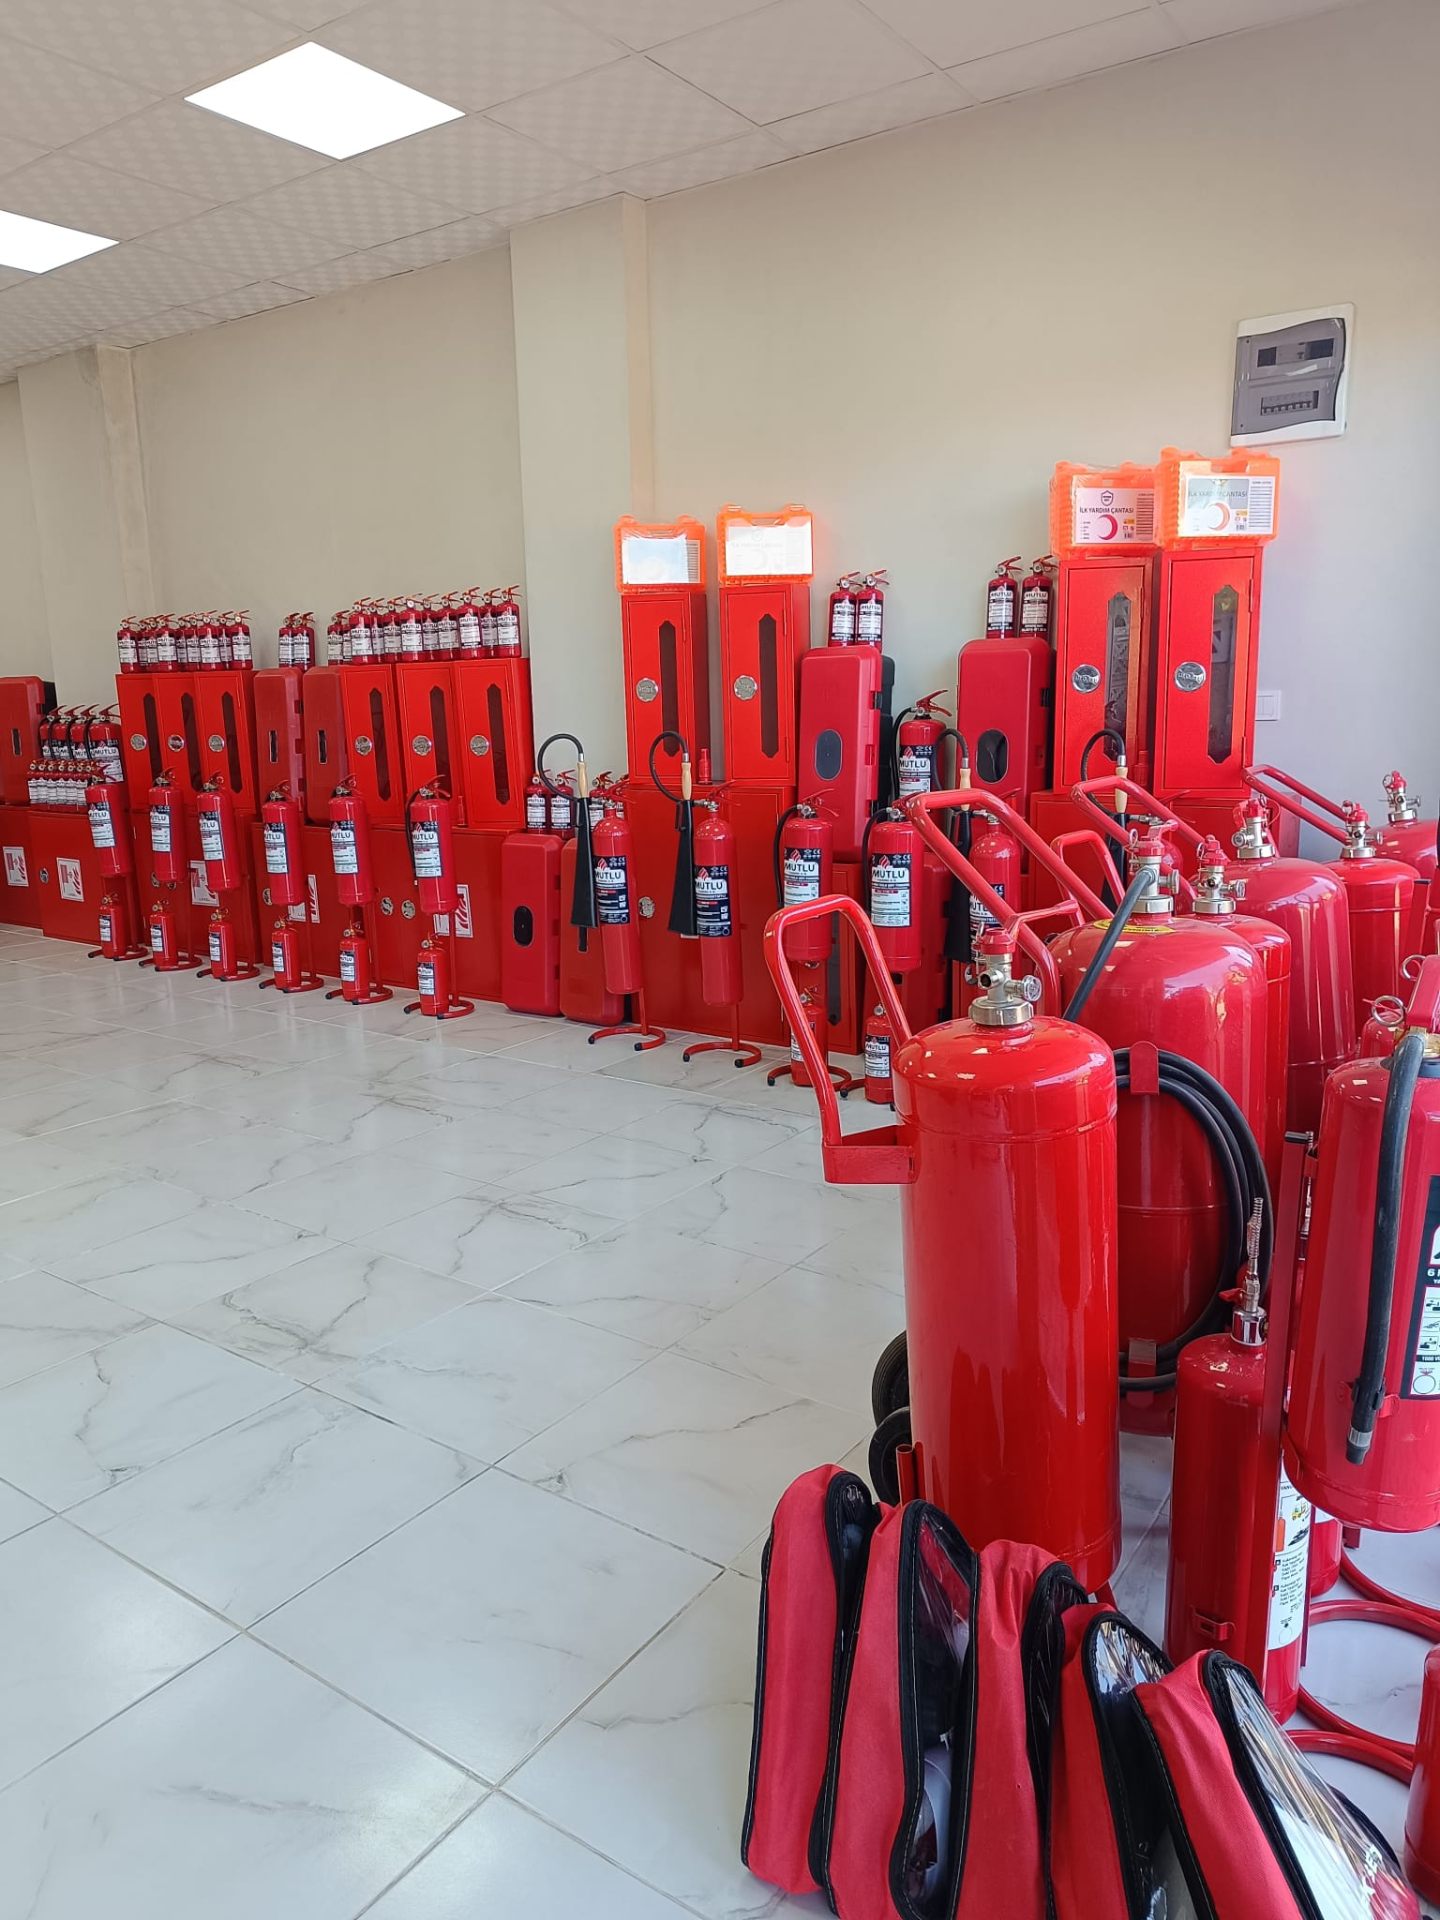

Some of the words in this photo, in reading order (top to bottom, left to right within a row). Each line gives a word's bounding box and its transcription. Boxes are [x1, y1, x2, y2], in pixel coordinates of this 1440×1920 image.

[900, 760, 927, 768] MUTLU
[786, 862, 815, 872] MUTLU
[873, 870, 905, 878] MUTLU
[1427, 1268, 1436, 1276] 6
